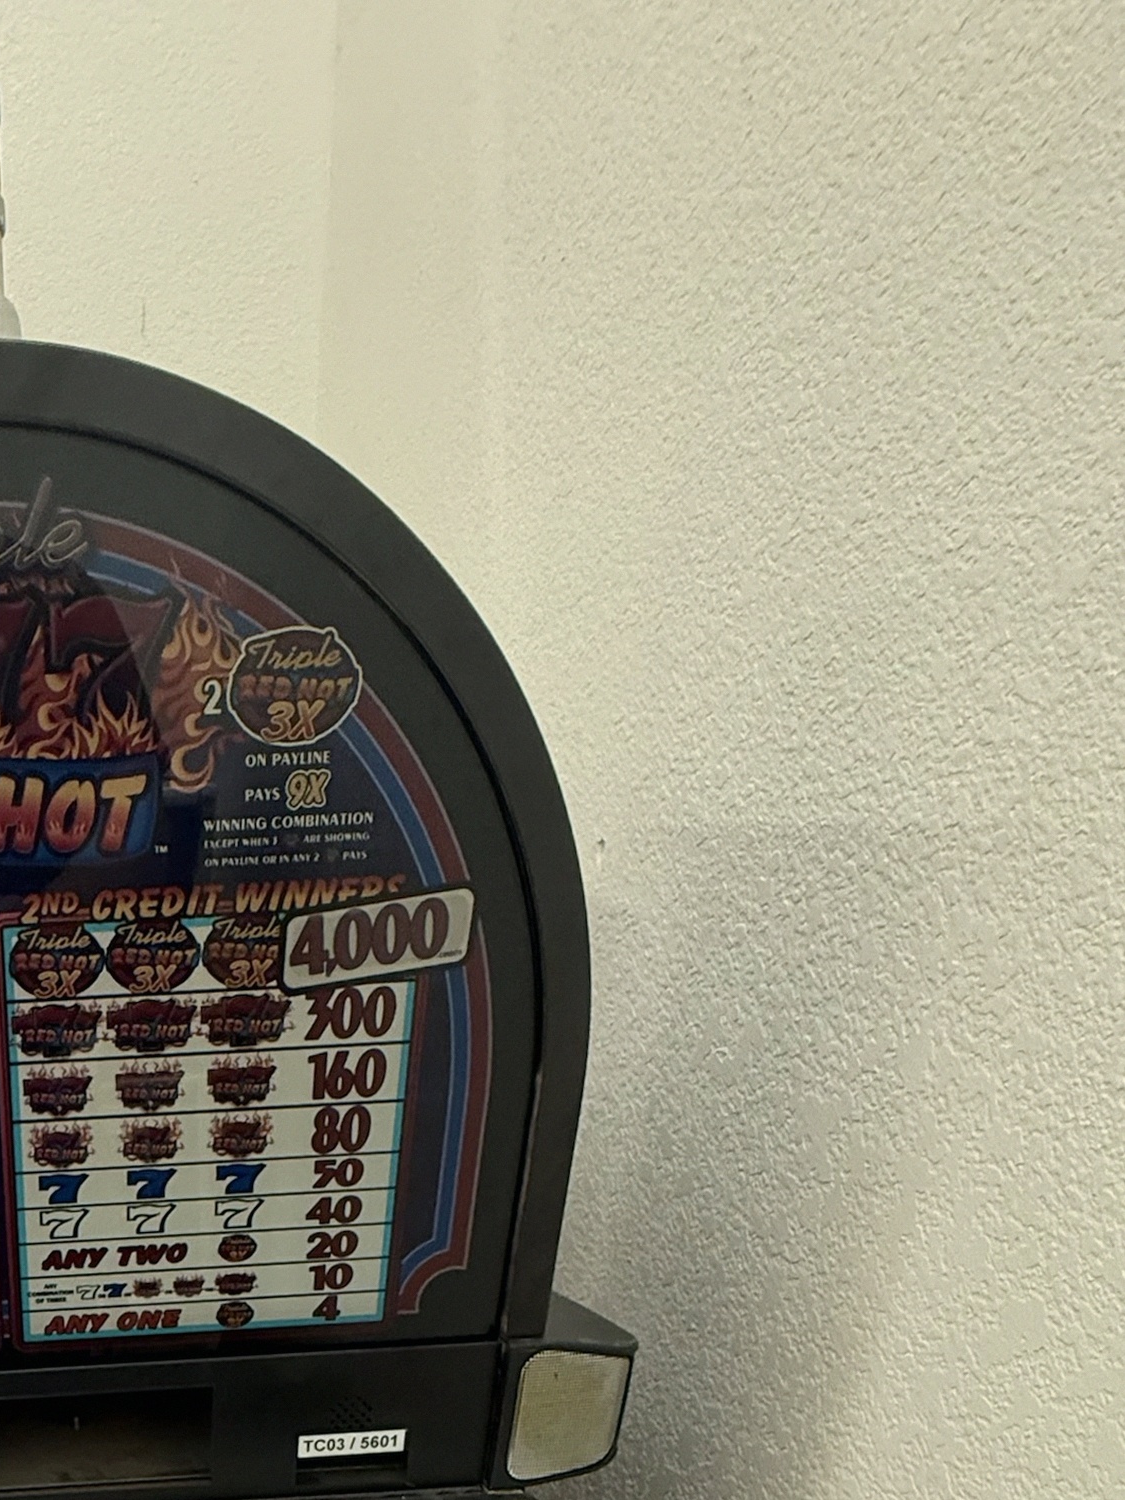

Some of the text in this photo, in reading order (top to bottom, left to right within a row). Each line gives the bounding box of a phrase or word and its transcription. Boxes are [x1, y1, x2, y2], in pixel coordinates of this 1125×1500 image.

[249, 636, 343, 670] Triple
[203, 680, 223, 714] 2
[261, 700, 326, 741] 3X
[245, 750, 331, 768] ON PAYLINE
[245, 769, 332, 811] PAYS 9X
[203, 812, 374, 832] WINNING COMBINATION
[21, 891, 80, 924] 2ND
[91, 884, 228, 921] CREDIT
[289, 895, 449, 977] 4,000
[308, 1048, 387, 1100] 160
[311, 1105, 371, 1154] 80
[312, 1157, 364, 1189] 50
[306, 1195, 363, 1224] 40
[41, 1243, 188, 1270] ANY TWO
[306, 1230, 359, 1259] 20
[309, 1263, 353, 1290] 10
[45, 1308, 182, 1335] ANY ONE
[312, 1294, 340, 1320] 4
[303, 1434, 399, 1454] TC03 / 5601
